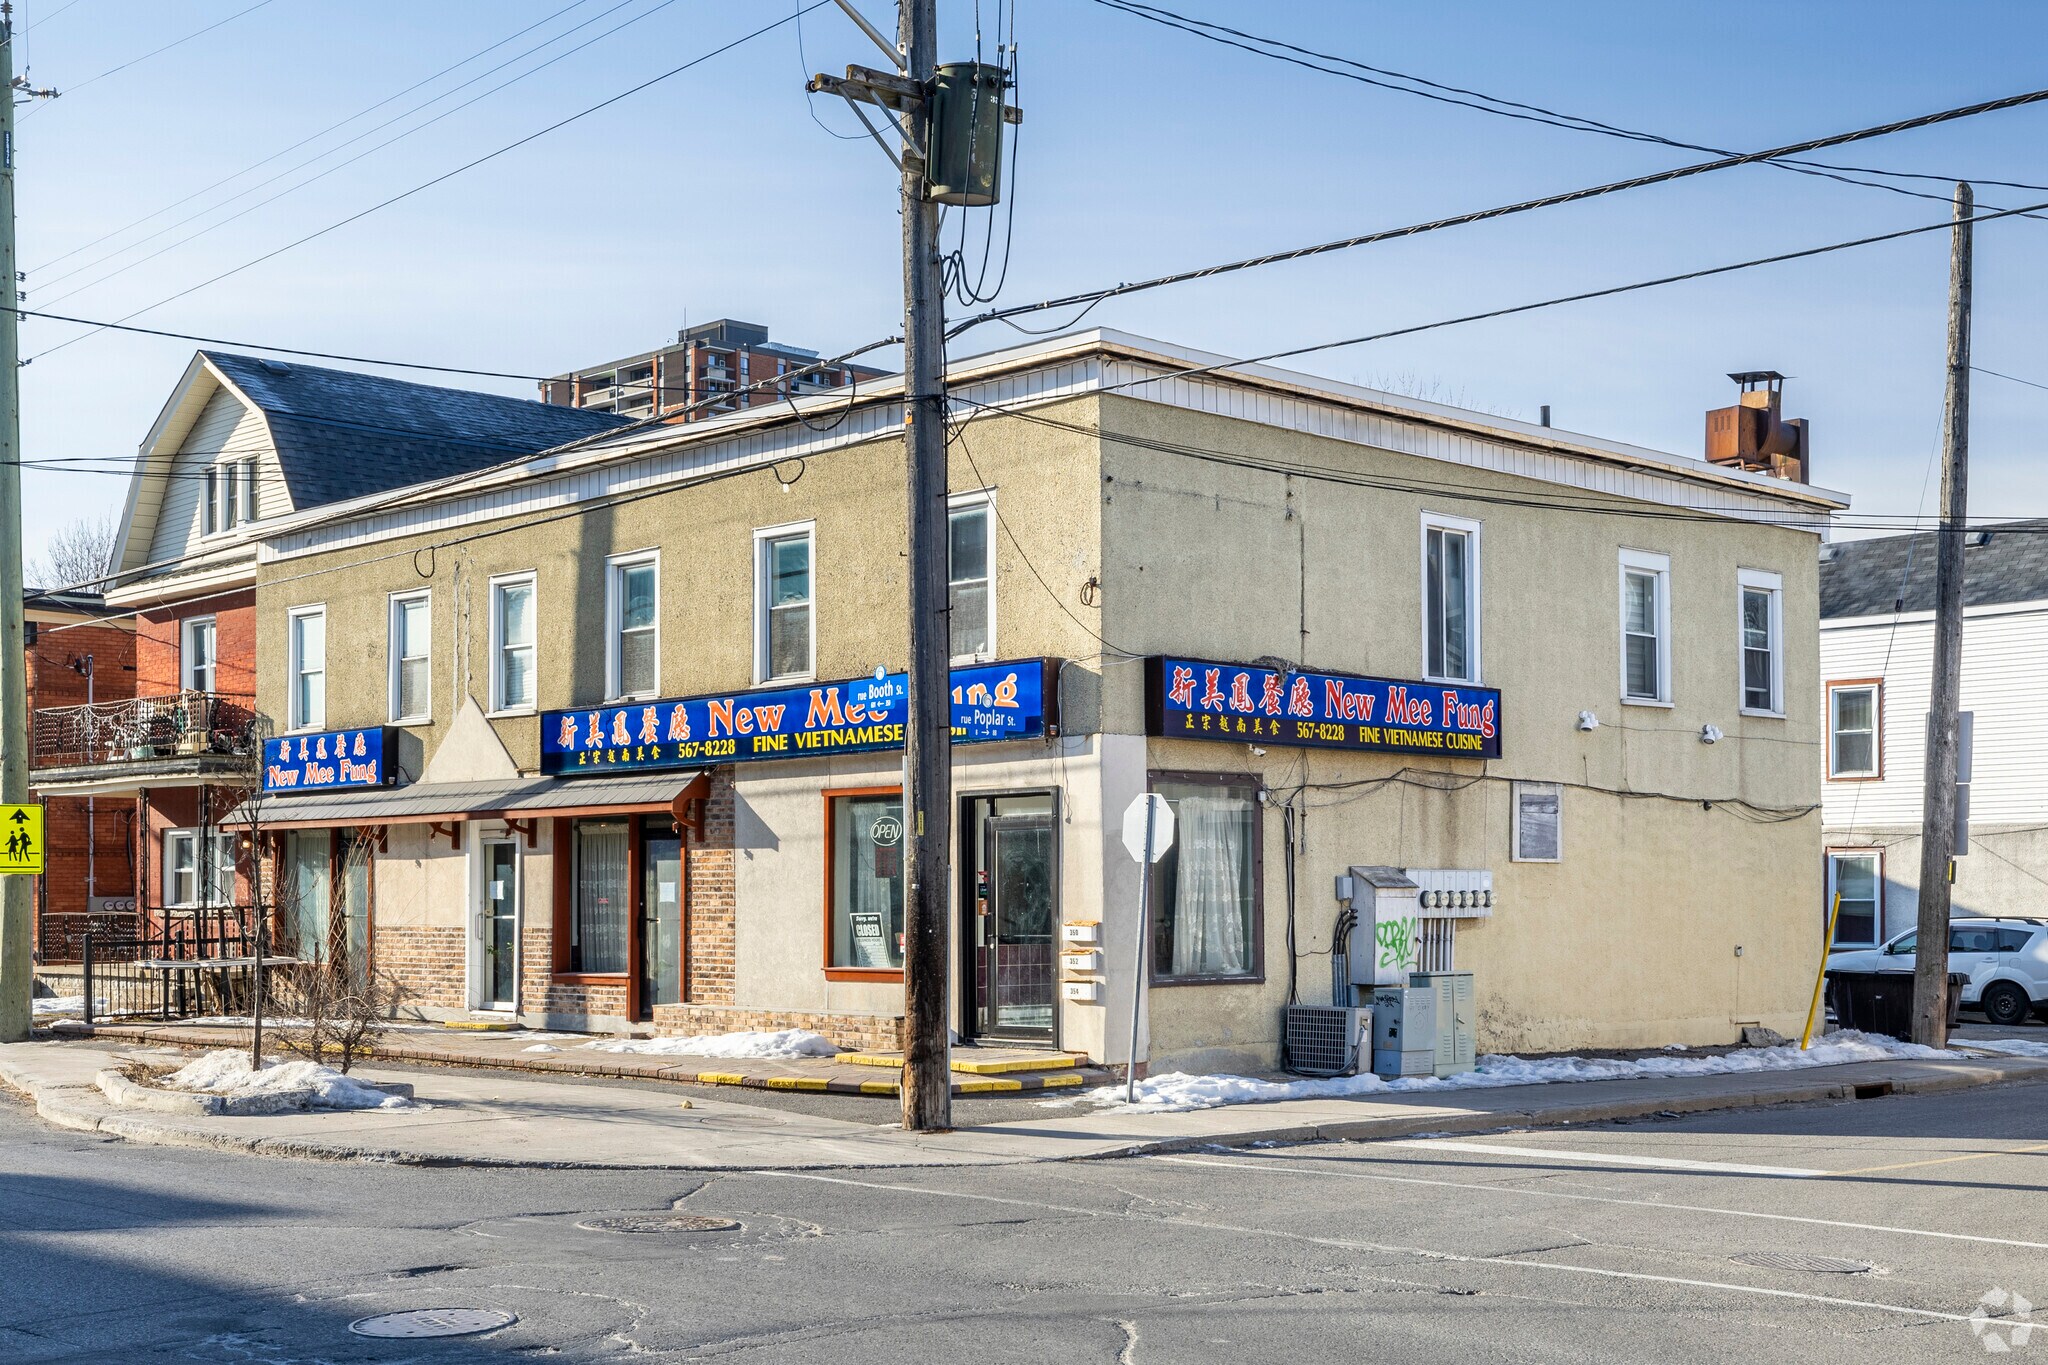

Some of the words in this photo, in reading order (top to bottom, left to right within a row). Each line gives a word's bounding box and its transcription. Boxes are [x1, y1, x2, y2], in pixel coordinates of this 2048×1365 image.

[857, 691, 867, 701] rue
[868, 680, 893, 699] Booth
[896, 685, 904, 695] St.
[1168, 665, 1313, 717] 新美鳳餐廳
[707, 699, 786, 738] New
[960, 716, 972, 724] rue
[974, 709, 1005, 729] Poplar
[1007, 716, 1016, 726] St.
[1324, 679, 1374, 722] New
[1385, 685, 1433, 726] Mee
[1441, 690, 1495, 738] Fung
[557, 704, 691, 750] 新美鳳餐廳
[678, 738, 736, 758] 567-8228
[753, 733, 788, 753] FINE
[795, 723, 904, 749] VIETNAMESE
[1297, 721, 1345, 741] 567-8228
[1359, 726, 1380, 744] FINE
[1383, 728, 1443, 748] VIETNAMESE
[1446, 732, 1483, 751] CUISINE
[268, 765, 299, 787] New
[304, 762, 334, 785] Mee
[339, 758, 377, 784] Fung
[872, 824, 900, 839] OPEN
[856, 924, 880, 936] CLOSED
